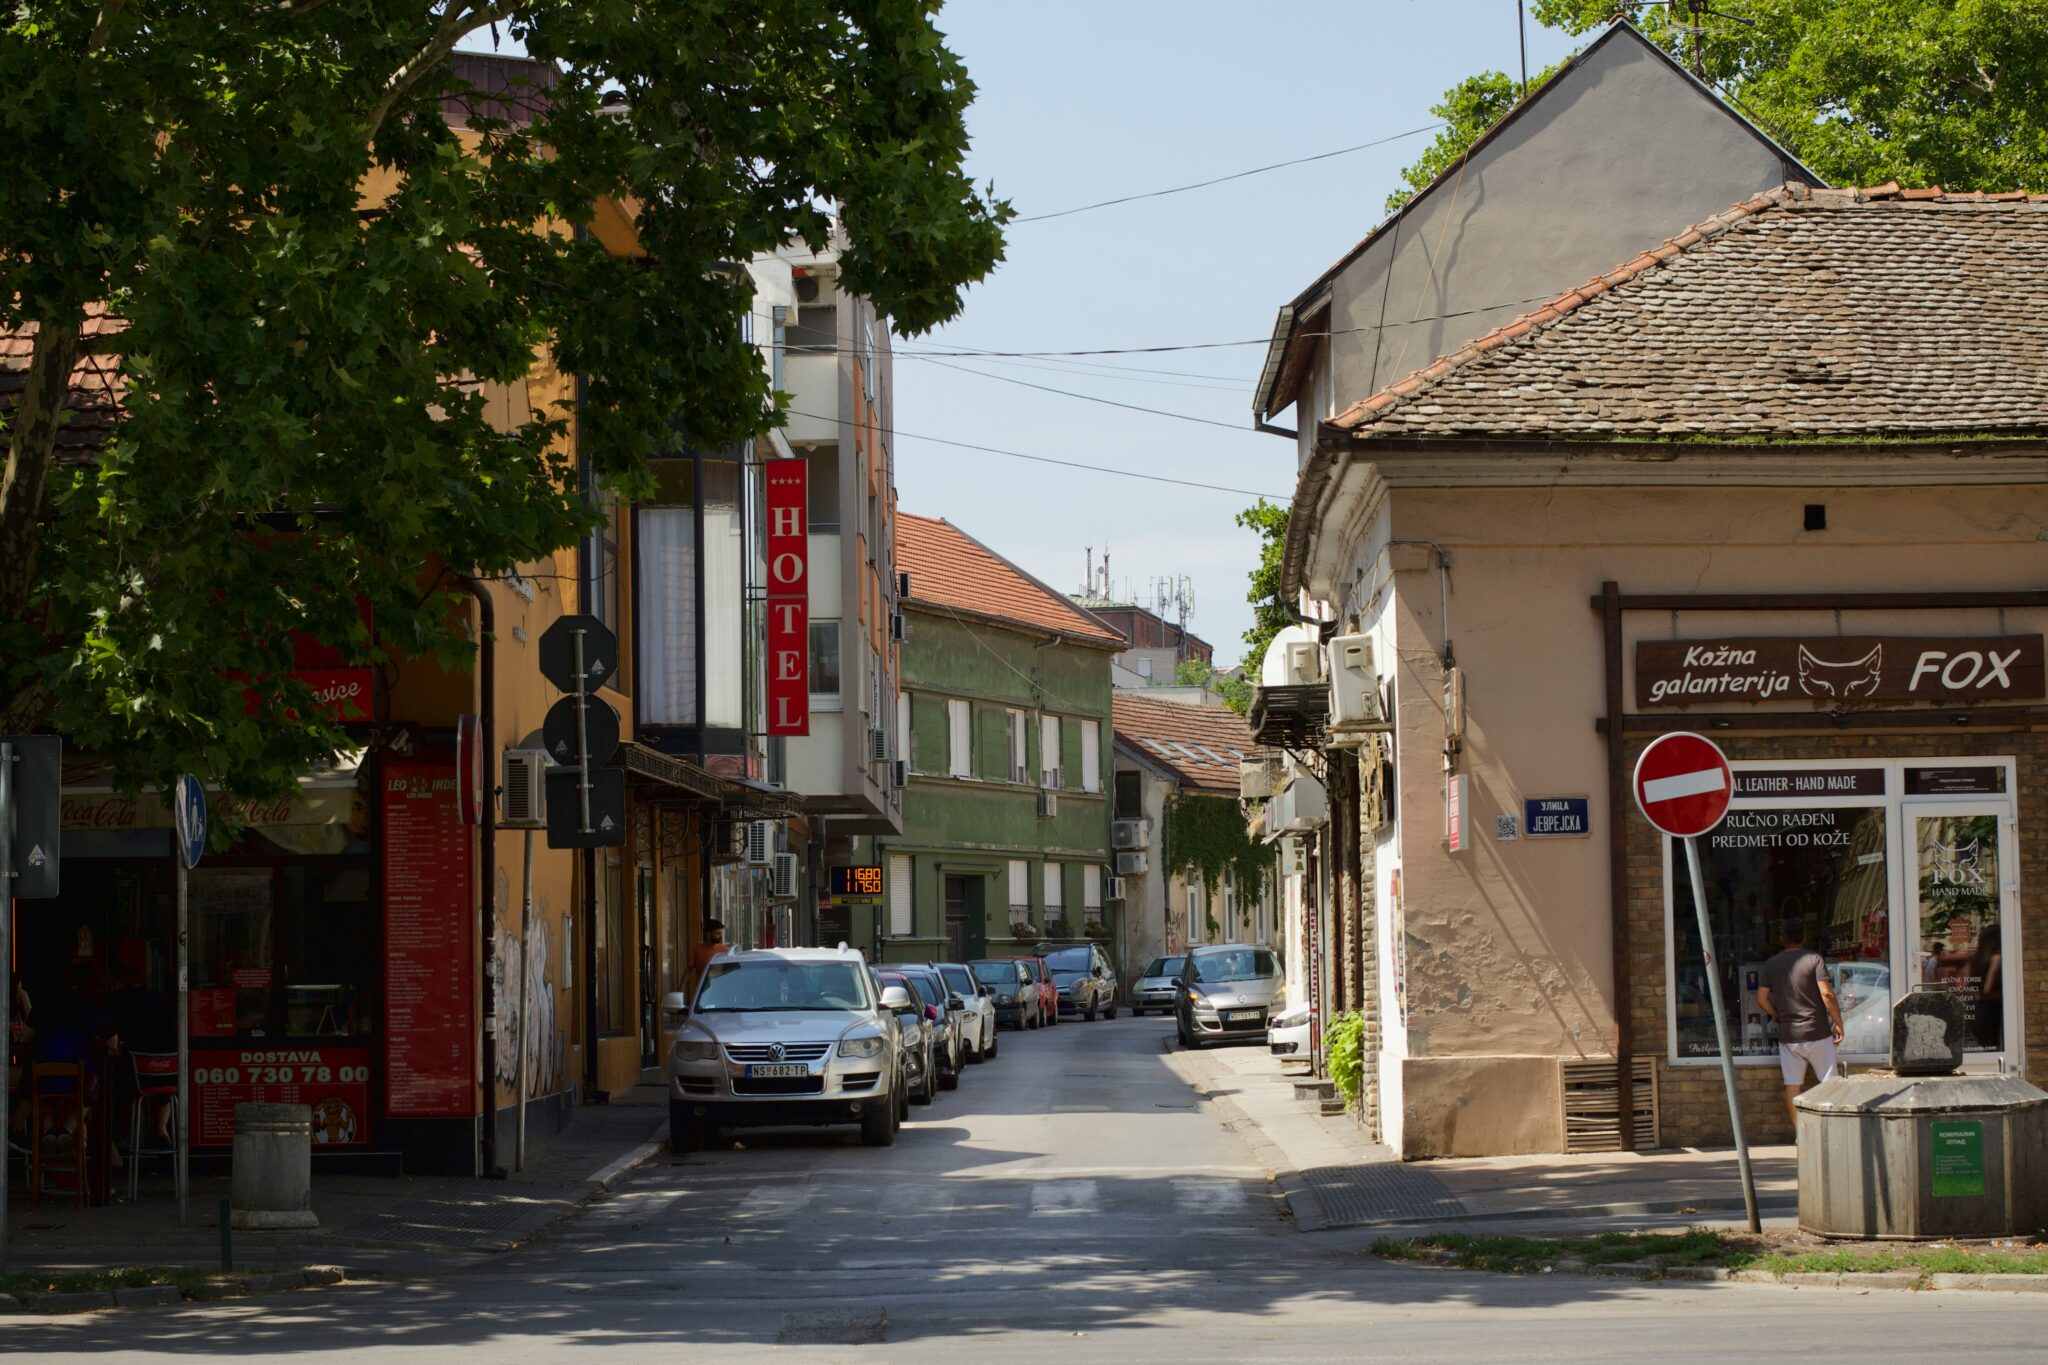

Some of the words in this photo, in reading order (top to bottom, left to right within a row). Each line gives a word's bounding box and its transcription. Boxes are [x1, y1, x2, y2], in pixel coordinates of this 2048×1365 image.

[771, 506, 804, 728] HOTEL
[1681, 645, 1755, 668] Kožna
[1908, 648, 2019, 692] FOX
[1649, 669, 1791, 703] galanterija
[387, 779, 407, 791] LEO
[432, 779, 457, 790] INDE
[1828, 775, 1857, 790] MADE
[1541, 801, 1569, 811] УЛИЦА
[1533, 815, 1581, 832] ЈЕВРЕЈСКА
[1726, 811, 1778, 828] RUČNO
[1782, 813, 1835, 828] RAĐENI
[1712, 834, 1782, 848] PREDMETI
[1786, 833, 1809, 847] OD
[1813, 829, 1851, 846] KOŽE
[1931, 868, 1986, 885] FOX
[1932, 887, 1959, 897] HAND
[241, 1051, 322, 1064] DOSTAVA
[194, 1068, 241, 1085] 060
[247, 1067, 294, 1084] 730
[301, 1067, 332, 1083] 78
[339, 1066, 370, 1083] 00
